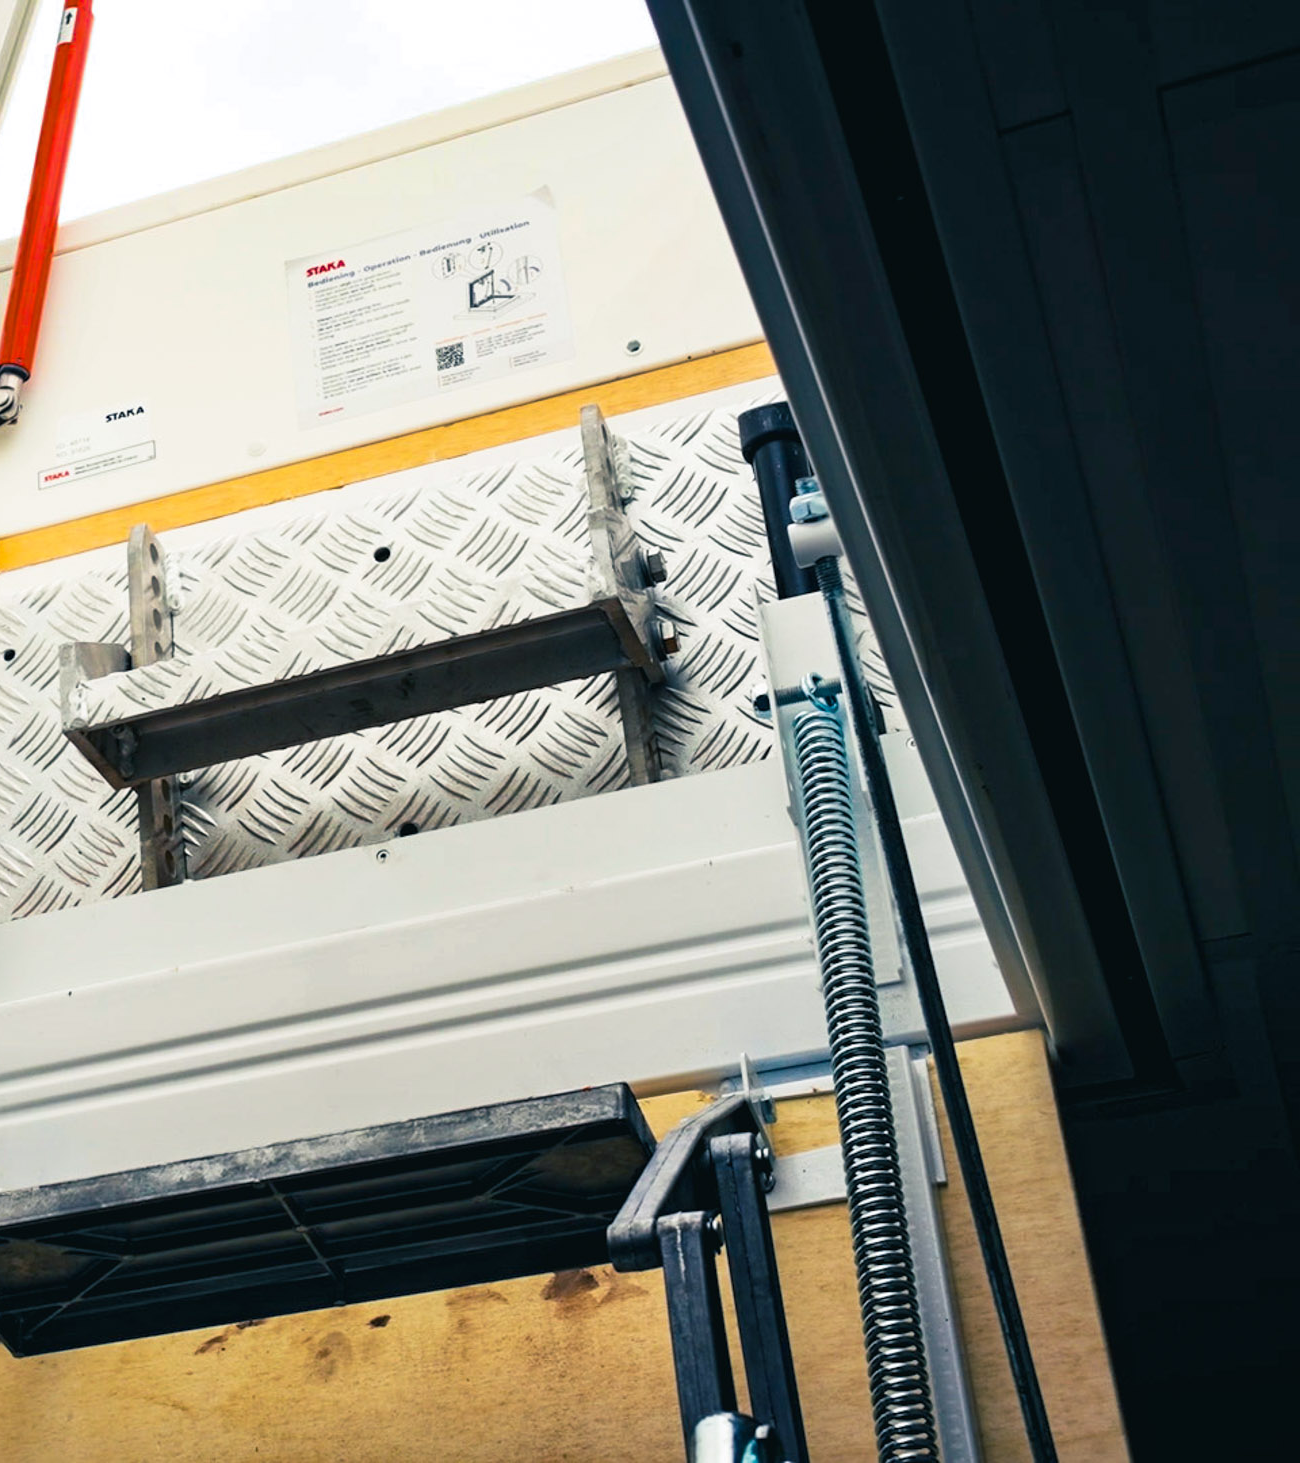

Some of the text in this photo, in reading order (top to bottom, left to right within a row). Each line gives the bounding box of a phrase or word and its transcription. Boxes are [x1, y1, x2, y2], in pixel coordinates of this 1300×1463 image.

[307, 221, 530, 288] Bediening Operation Bedienung Utilisation
[306, 260, 346, 277] STAKA
[105, 406, 145, 423] STAKA
[44, 471, 69, 482] STAKA
